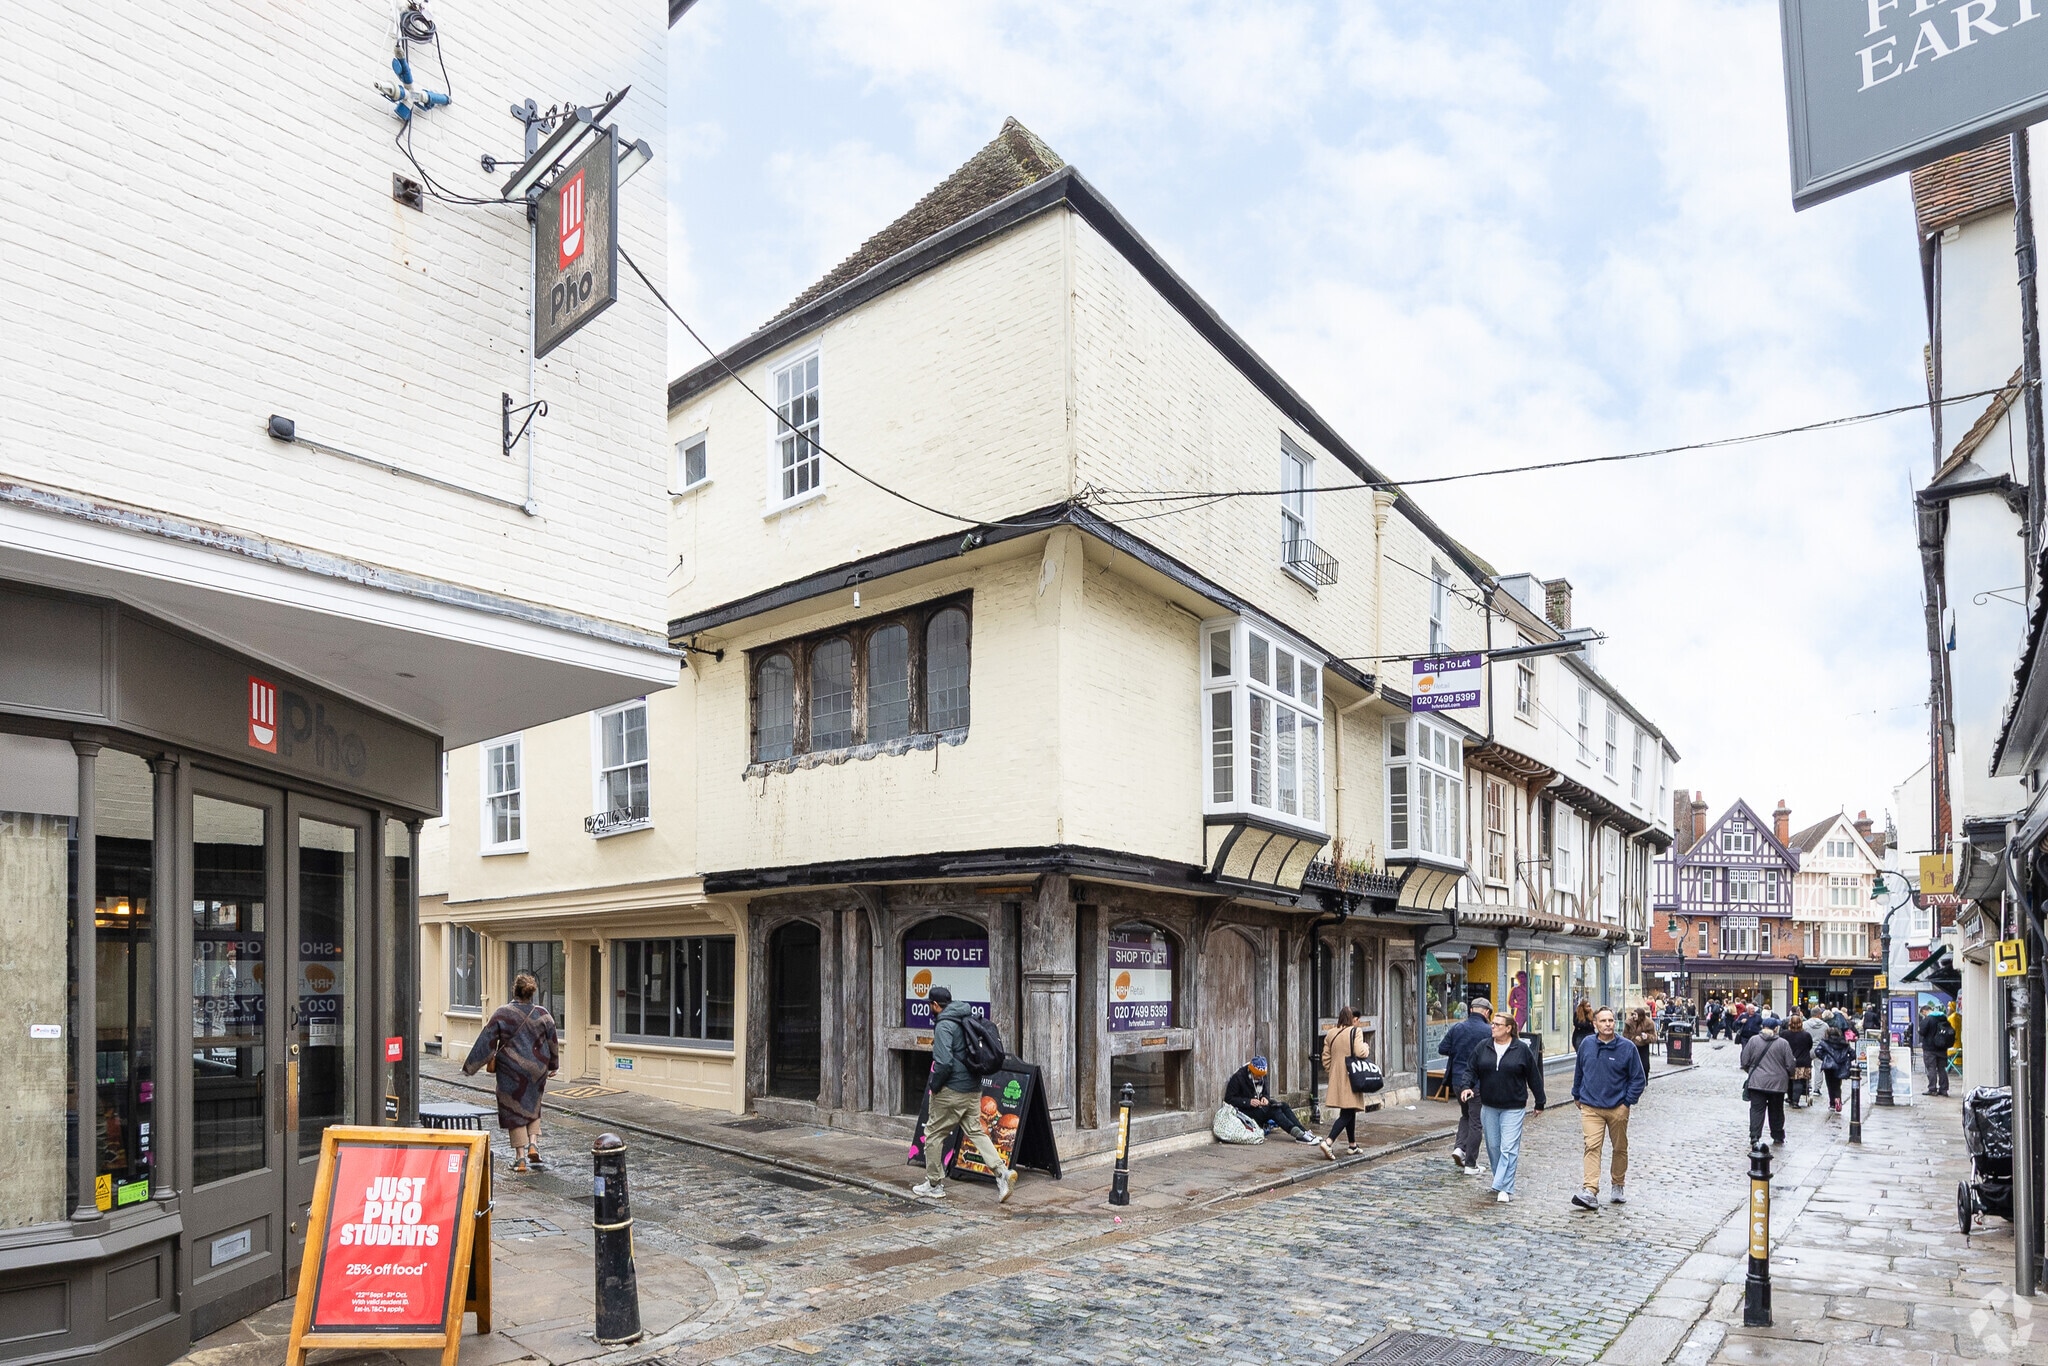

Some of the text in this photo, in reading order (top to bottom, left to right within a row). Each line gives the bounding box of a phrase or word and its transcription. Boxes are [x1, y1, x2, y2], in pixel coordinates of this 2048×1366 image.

[551, 271, 592, 326] Pho
[1446, 661, 1456, 669] To
[1457, 659, 1471, 668] Let
[1417, 692, 1476, 705] 020 7499 5399
[283, 690, 366, 778] Pho
[1927, 894, 1962, 905] EWM
[913, 948, 983, 961] SHOP TO LET
[1115, 951, 1167, 964] SHOP TO LET
[913, 983, 930, 993] HRH
[1115, 986, 1146, 995] HRH Retail
[911, 1003, 930, 1016] 020
[1114, 1005, 1168, 1018] 020 7499 5399
[366, 1177, 426, 1201] JUST
[362, 1201, 422, 1225] PHO
[340, 1224, 439, 1246] STUDENTS
[346, 1264, 372, 1275] 25%
[374, 1263, 391, 1275] off
